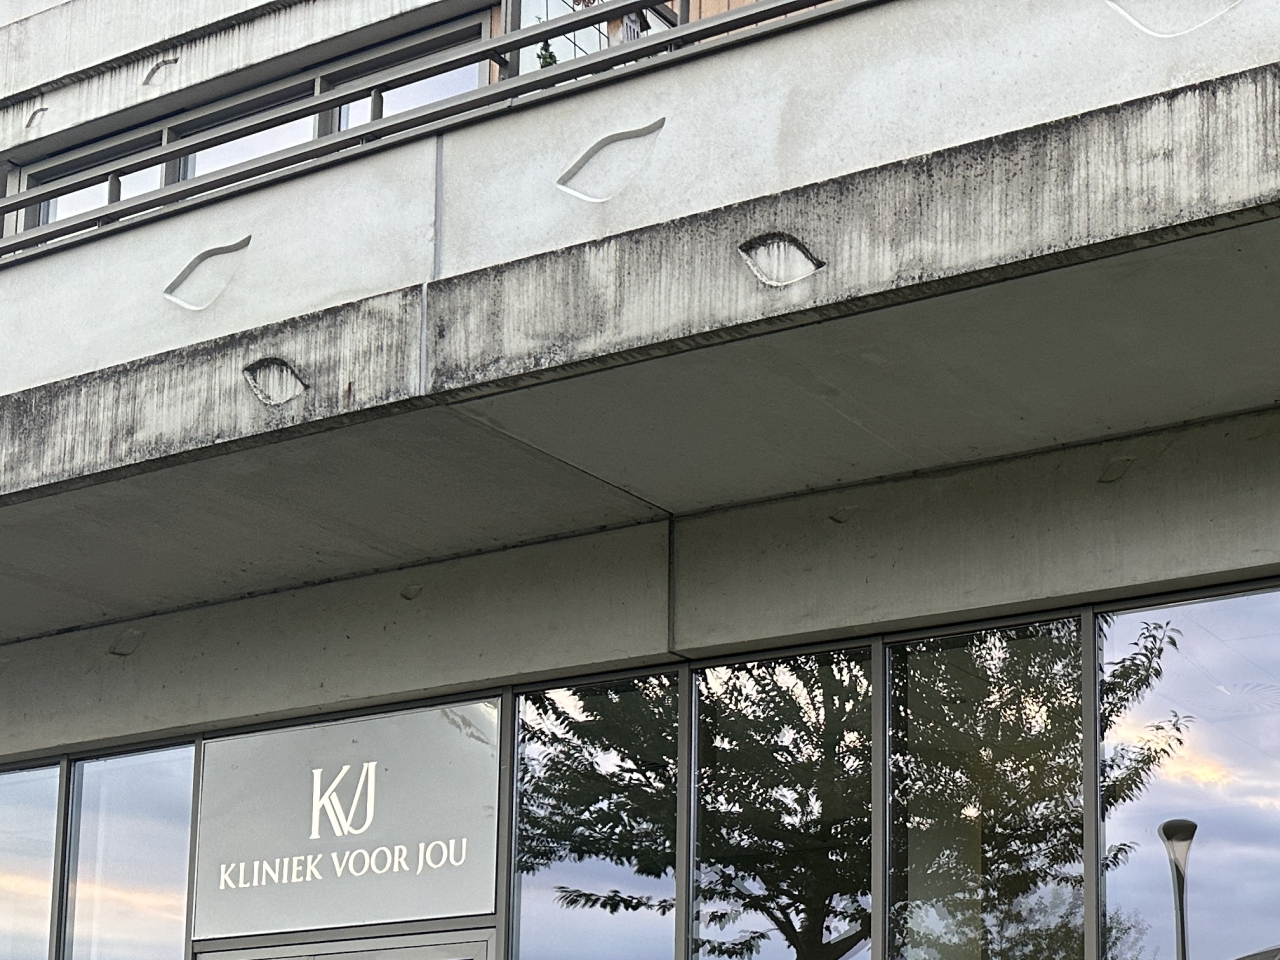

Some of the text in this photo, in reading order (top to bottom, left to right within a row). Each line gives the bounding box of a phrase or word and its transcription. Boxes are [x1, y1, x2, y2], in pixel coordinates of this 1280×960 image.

[309, 761, 377, 839] KVJ
[219, 838, 468, 889] KLINIEK VOOR JOU
